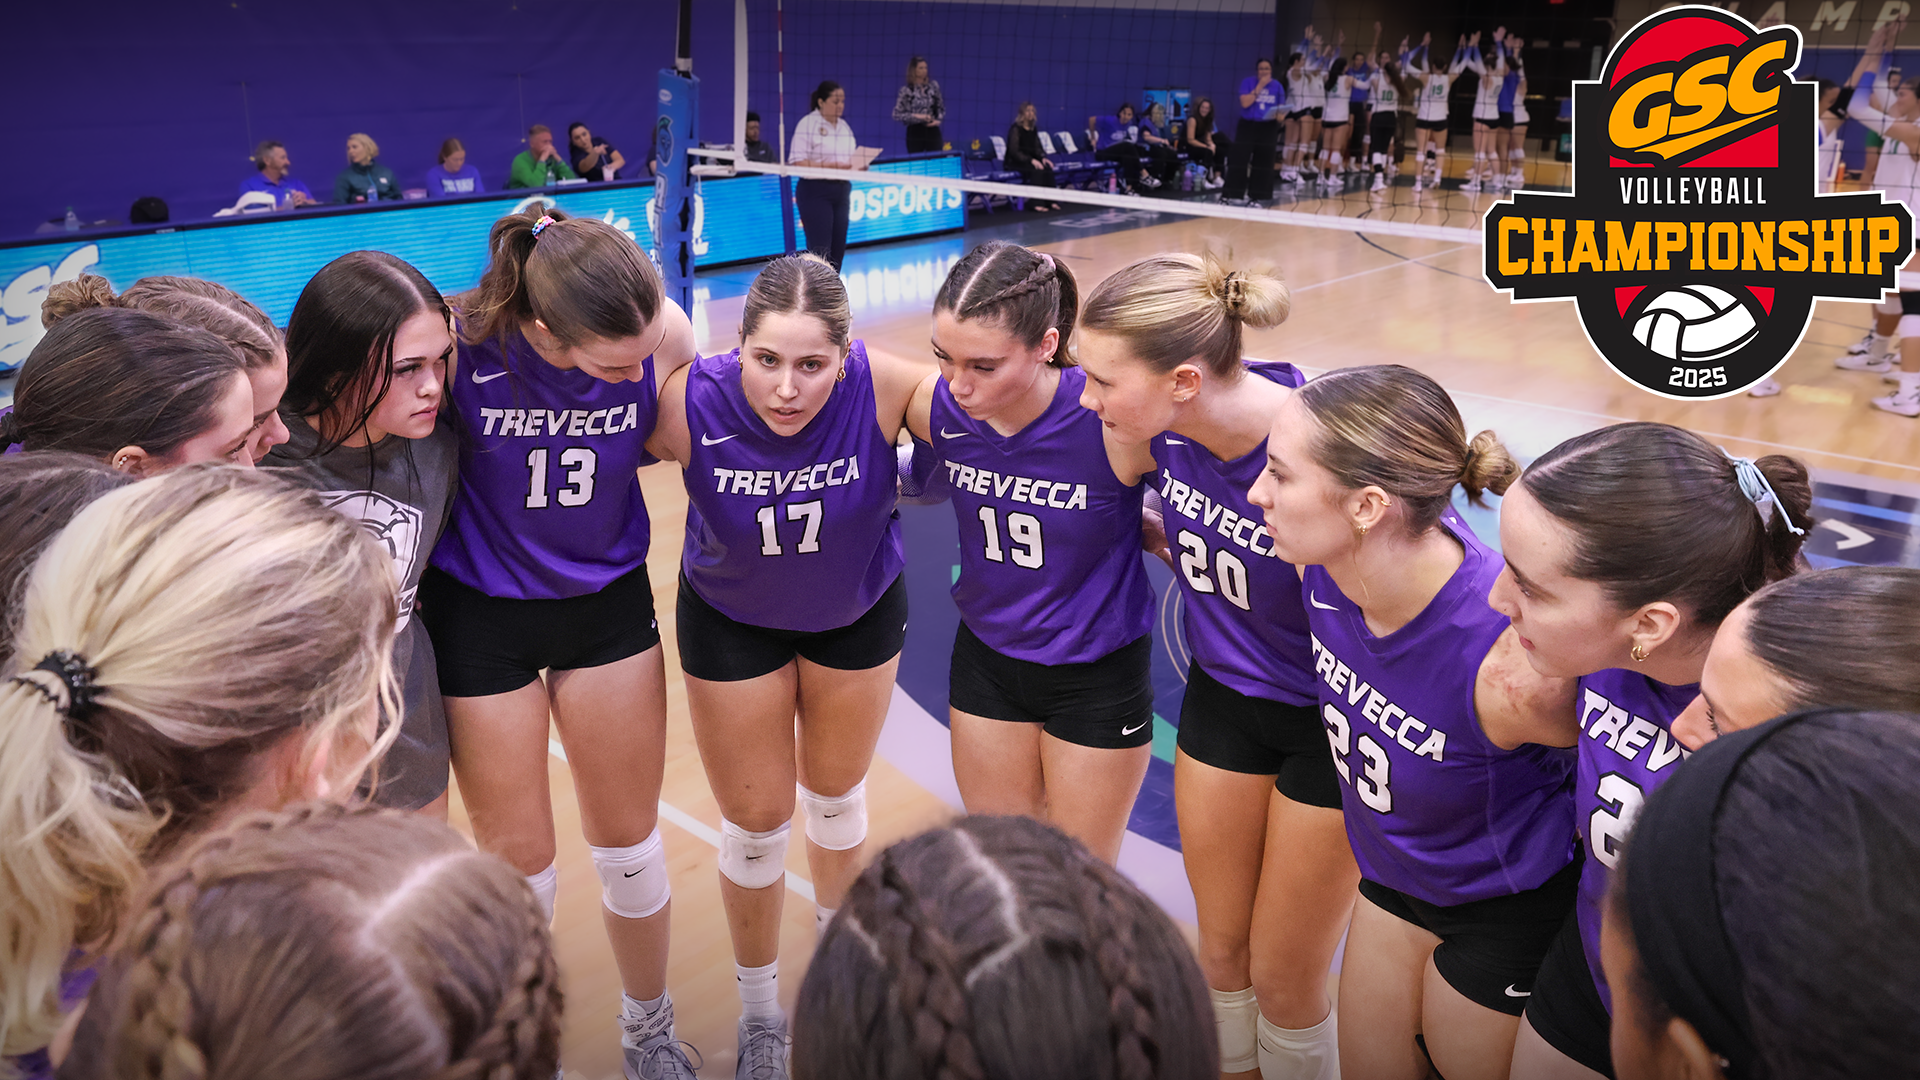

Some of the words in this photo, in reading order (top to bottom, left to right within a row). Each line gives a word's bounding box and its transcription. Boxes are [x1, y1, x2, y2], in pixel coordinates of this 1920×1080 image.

[1381, 90, 1394, 102] 10
[480, 402, 638, 437] TREVECCA
[525, 447, 598, 509] 13
[713, 455, 860, 496] TREVECCA
[944, 459, 1088, 510] TREVECCA
[756, 499, 824, 556] 17
[978, 504, 1045, 570] 19
[1177, 528, 1251, 611] 20
[1310, 630, 1447, 762] TREVECCA
[1323, 702, 1393, 815] 23
[1579, 687, 1693, 773] TREV
